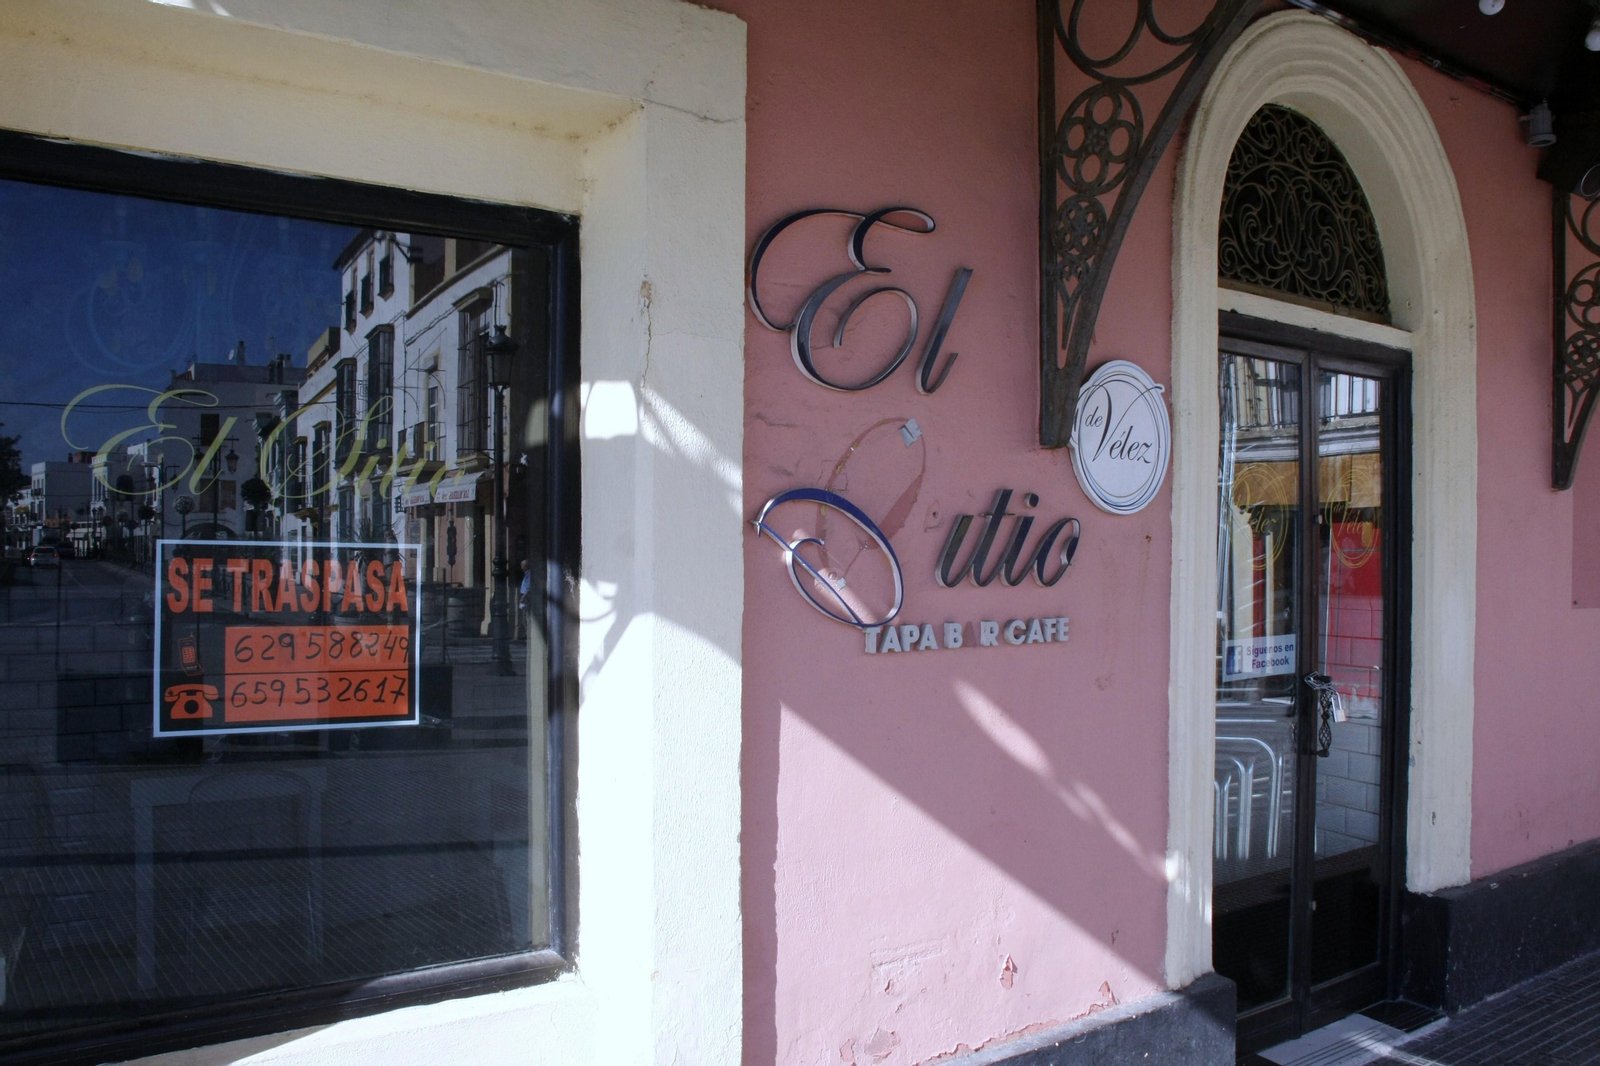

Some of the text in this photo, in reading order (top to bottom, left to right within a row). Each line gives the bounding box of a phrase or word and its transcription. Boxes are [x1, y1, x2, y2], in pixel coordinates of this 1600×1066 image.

[748, 206, 973, 395] El
[60, 384, 238, 496] El
[1079, 384, 1163, 464] de Vélez
[166, 557, 409, 613] SE TRASPASA
[864, 623, 939, 653] TAPA
[1003, 617, 1069, 645] CAFE
[1252, 655, 1290, 669] Facebook
[1284, 643, 1294, 652] en
